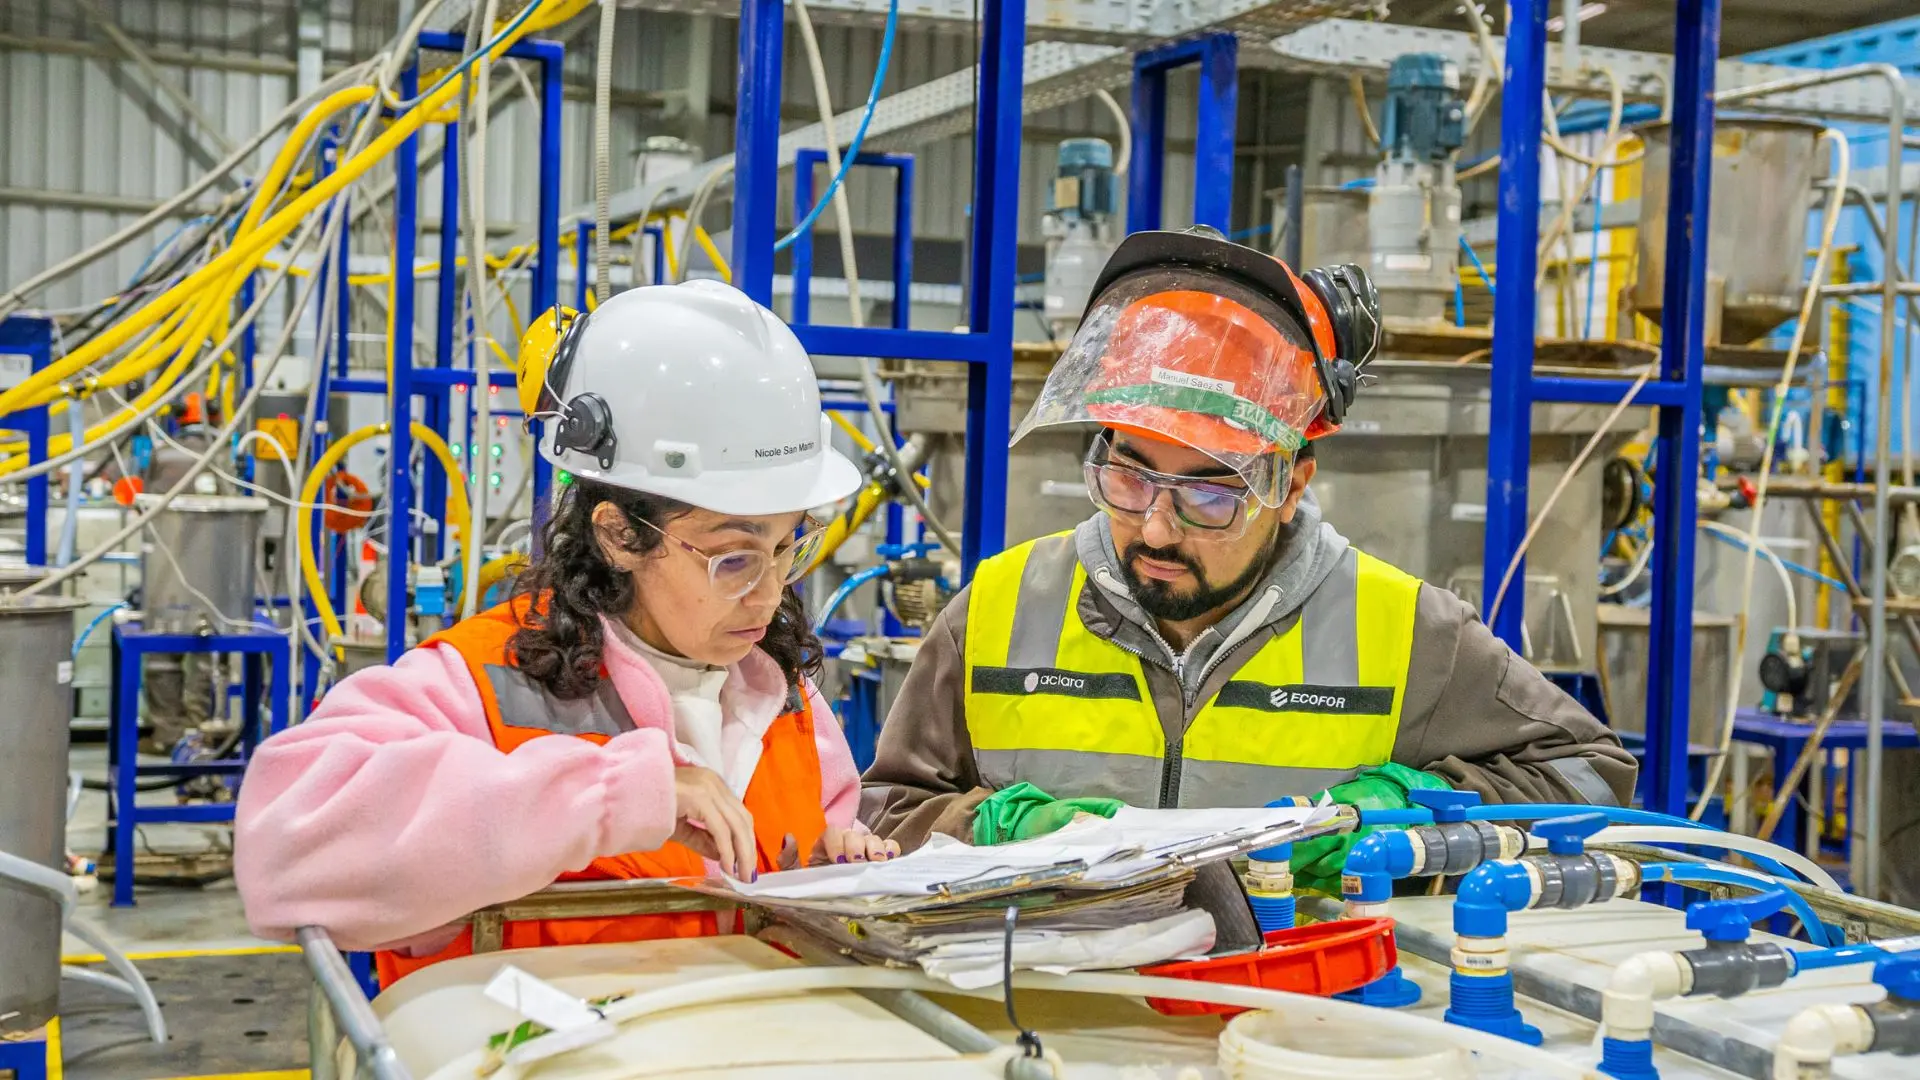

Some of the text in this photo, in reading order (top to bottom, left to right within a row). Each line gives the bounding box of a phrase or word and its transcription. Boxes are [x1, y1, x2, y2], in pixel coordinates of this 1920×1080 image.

[1158, 371, 1189, 385] Manuel
[755, 448, 782, 458] Nicole
[783, 445, 797, 455] San
[1040, 674, 1085, 690] aclara
[1290, 692, 1346, 708] ECOFOR
